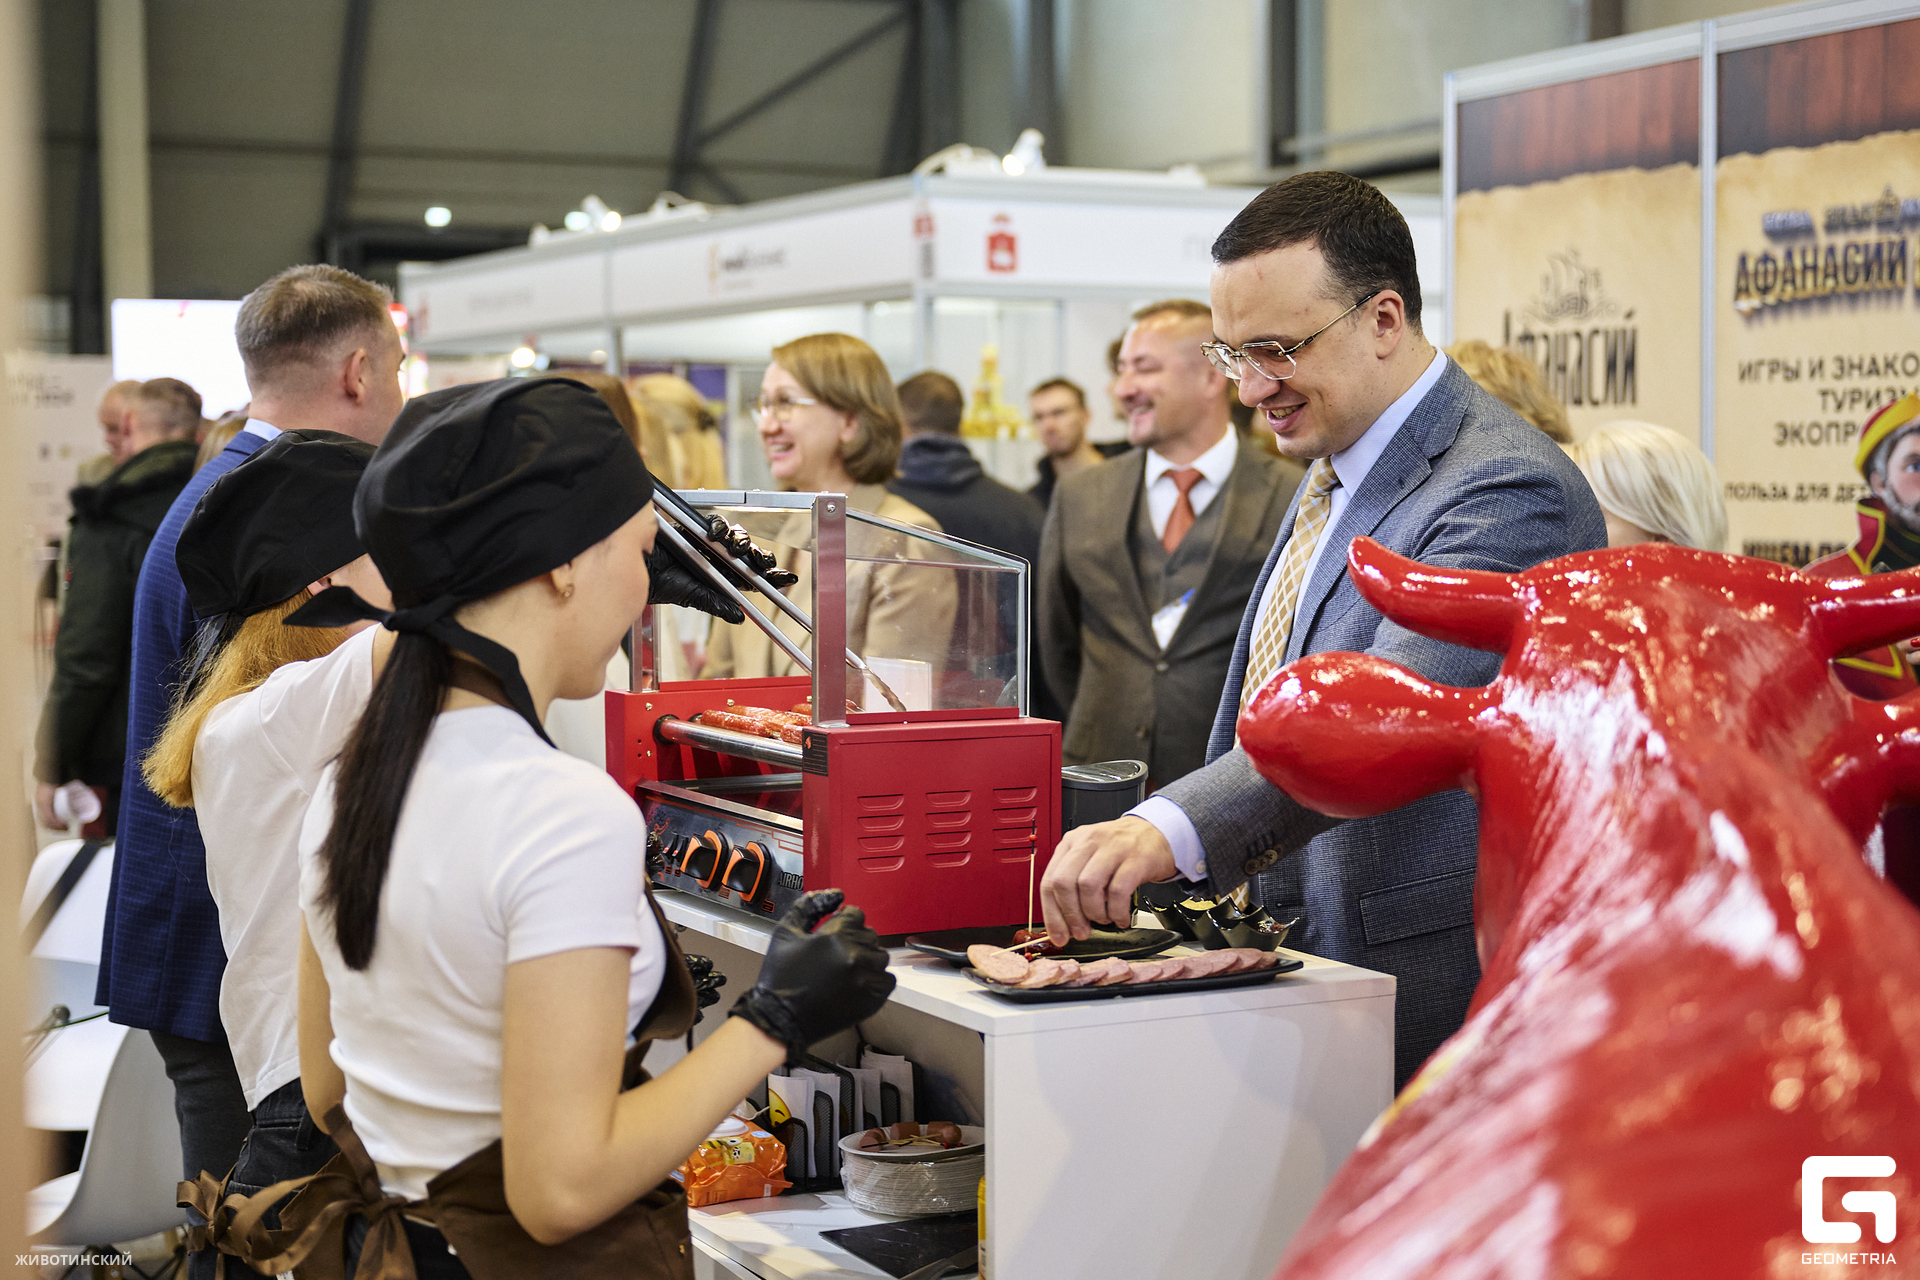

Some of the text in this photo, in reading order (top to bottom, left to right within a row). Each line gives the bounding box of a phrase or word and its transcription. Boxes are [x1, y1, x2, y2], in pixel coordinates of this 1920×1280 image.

[1738, 358, 1801, 383] ИГРЫ
[1808, 356, 1825, 381] И
[1774, 420, 1861, 447] ЭКОПР
[1794, 482, 1829, 501] ДЛЯ
